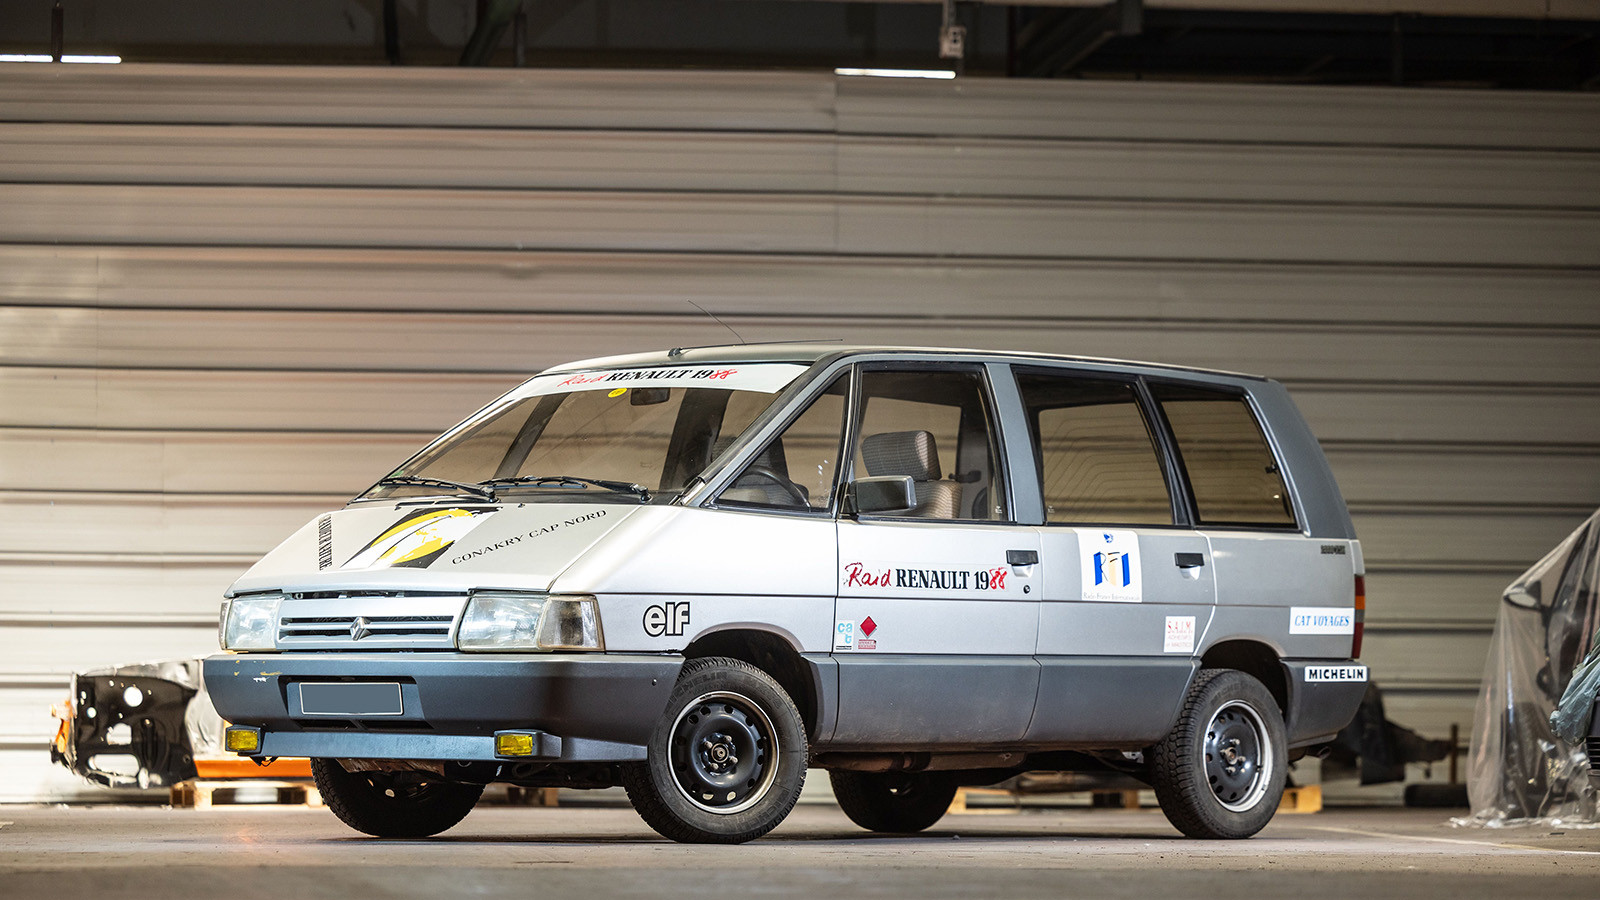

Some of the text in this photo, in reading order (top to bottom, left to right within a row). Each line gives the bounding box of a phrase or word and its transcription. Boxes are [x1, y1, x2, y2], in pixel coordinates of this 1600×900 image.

[605, 370, 693, 382] RENAULT
[451, 509, 607, 565] CONAKRY CAP NORD
[844, 562, 1008, 590] Raid RENAULT 1988
[642, 601, 691, 637] elf
[1294, 615, 1350, 627] CAT VOYAGES
[1308, 669, 1364, 679] MICHELIN
